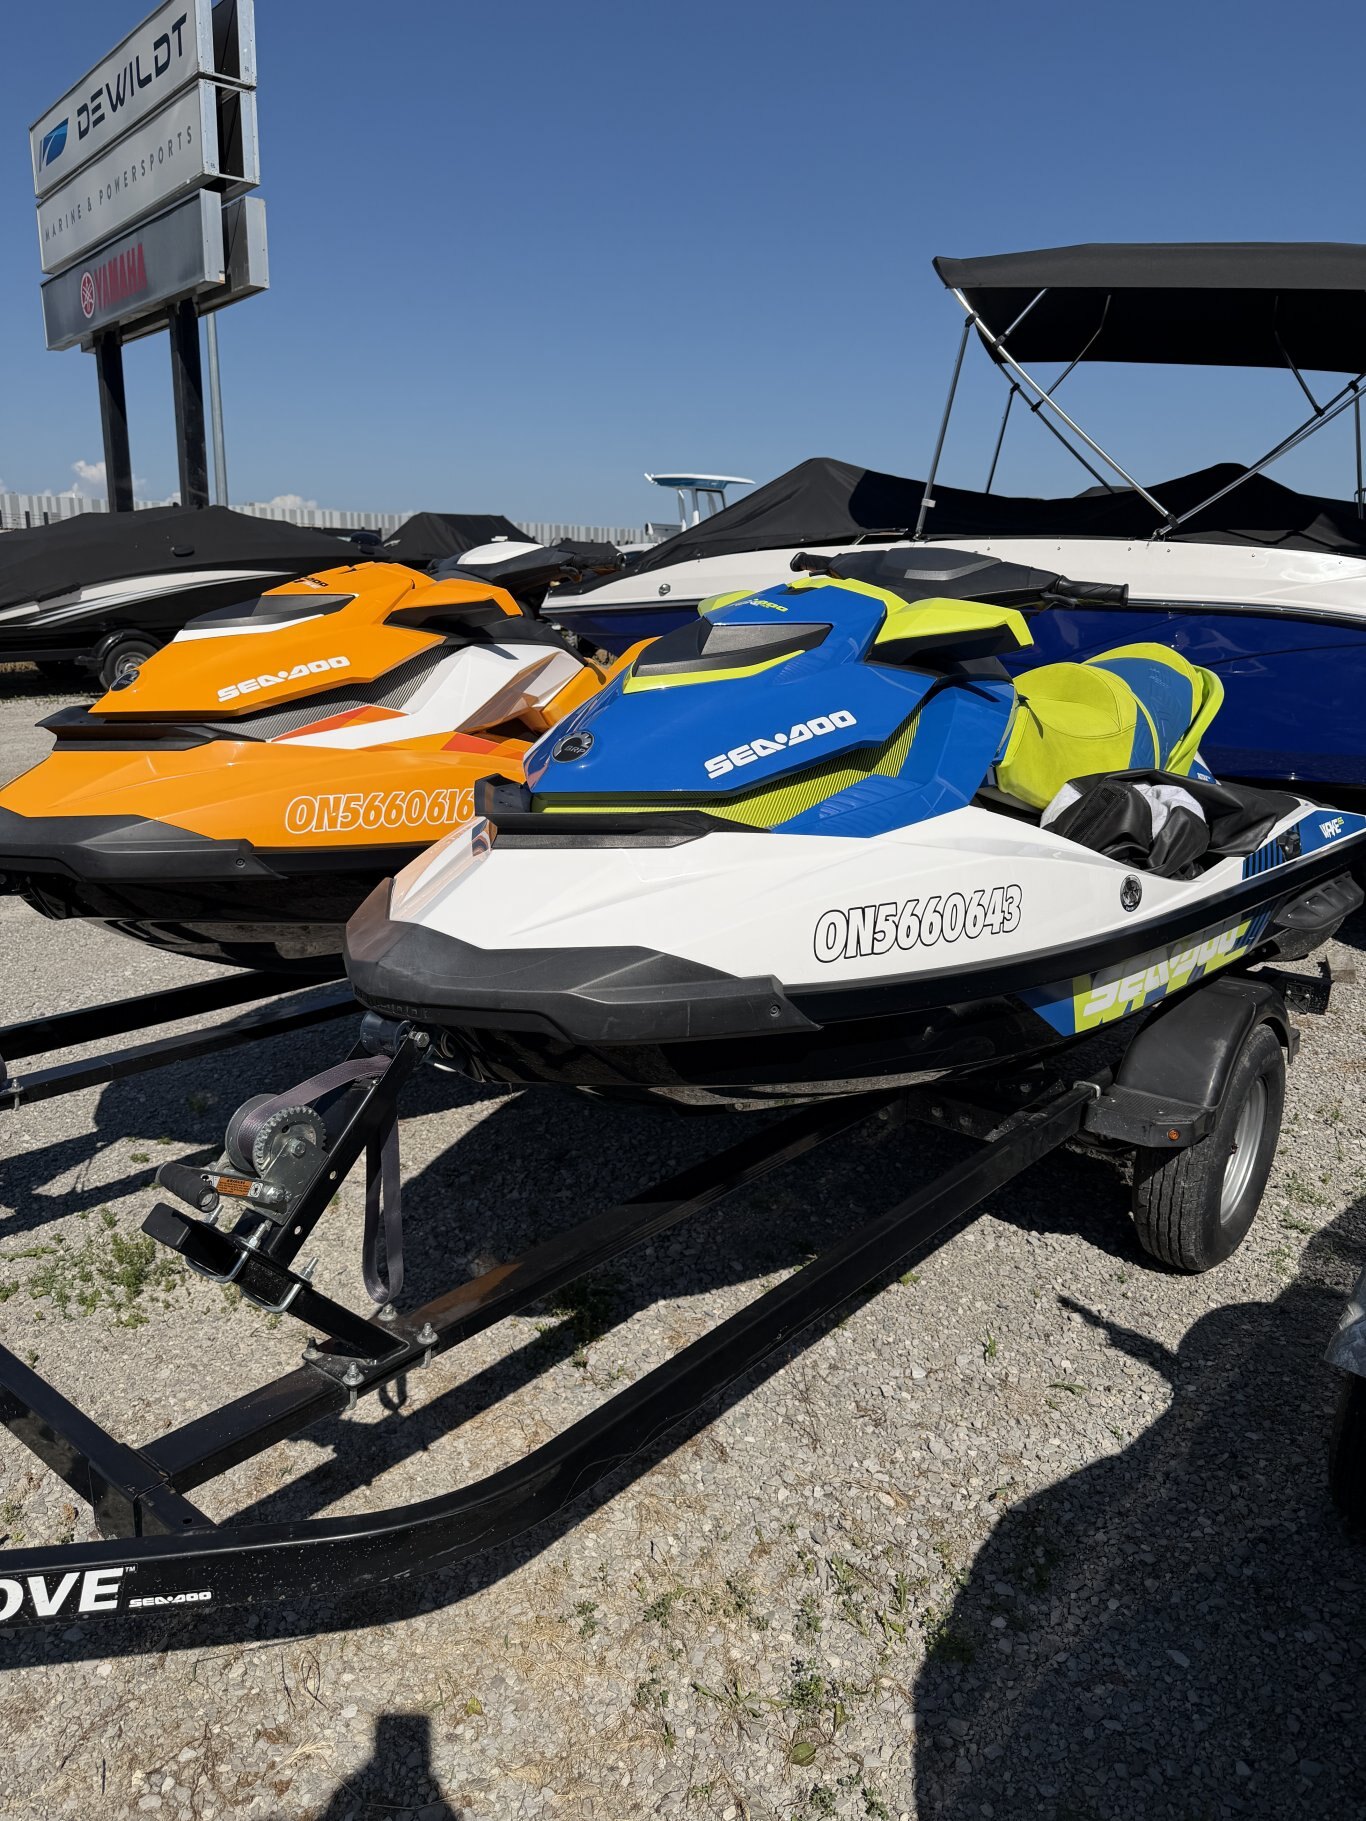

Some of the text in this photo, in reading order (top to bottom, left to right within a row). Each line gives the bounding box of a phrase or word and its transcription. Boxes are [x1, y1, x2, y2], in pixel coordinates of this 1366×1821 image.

[77, 12, 187, 141] DEWILDT
[45, 125, 192, 242] MARINE & POWERSPORTS
[93, 244, 147, 309] YAMAHA
[285, 788, 474, 834] ON5660616
[813, 884, 1023, 963] ON5660643
